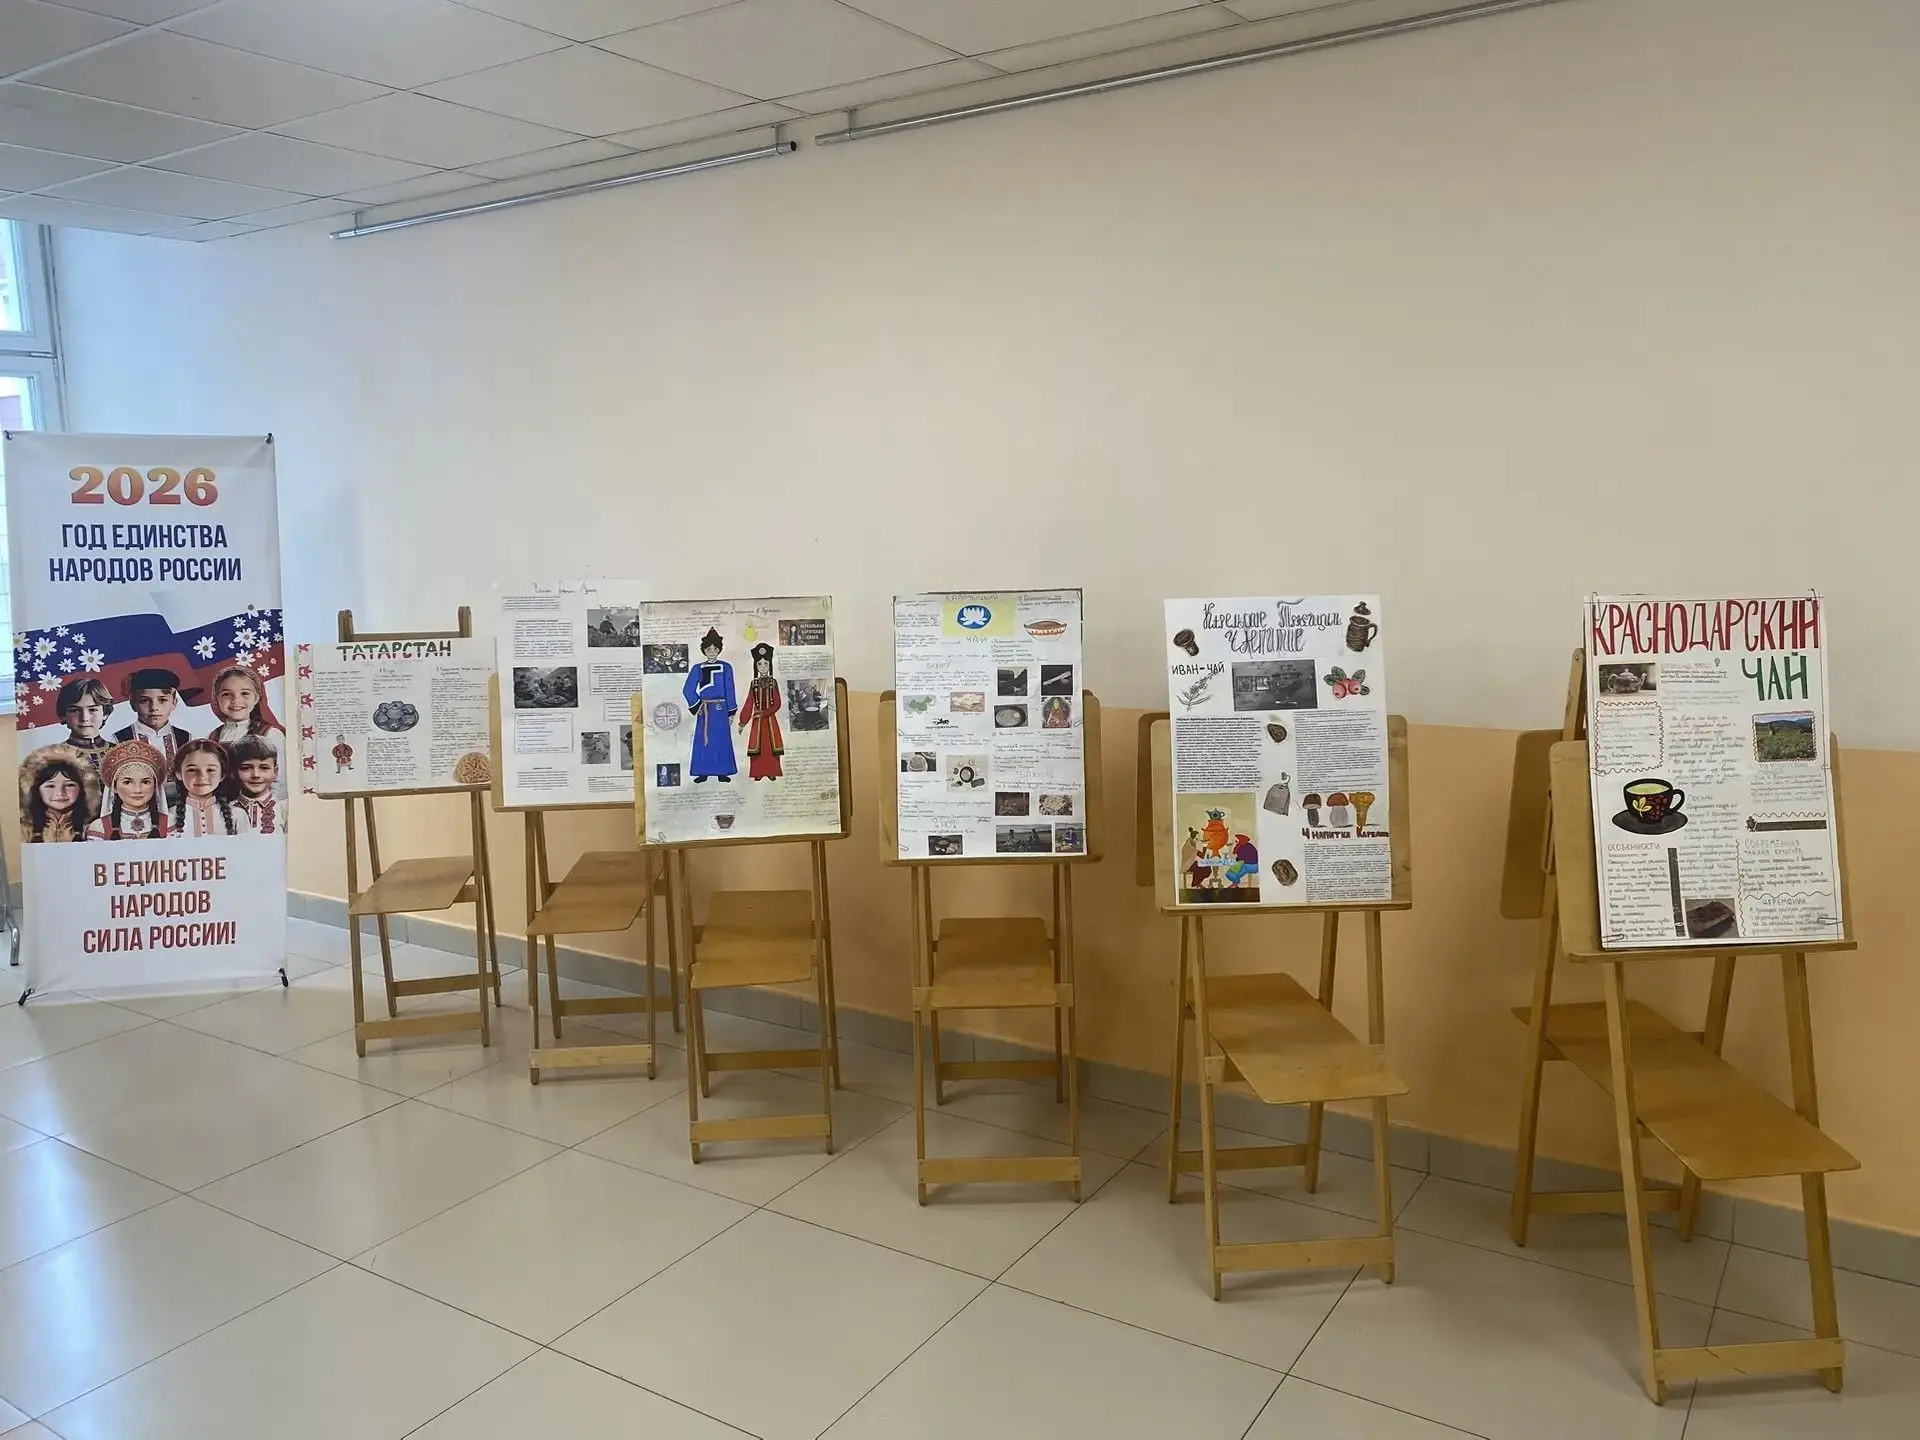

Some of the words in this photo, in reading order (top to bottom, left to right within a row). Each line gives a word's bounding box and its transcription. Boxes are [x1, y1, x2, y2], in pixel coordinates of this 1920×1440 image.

[68, 465, 219, 507] 2026
[62, 524, 107, 550] ГОД
[112, 522, 228, 550] ЕДИНСТВА
[49, 557, 154, 585] НАРОДОВ
[159, 557, 242, 582] РОССИИ
[1592, 598, 1820, 656] КРАСНОДАРСКИЙ
[336, 640, 451, 661] ТАТАРСТАН
[1171, 661, 1225, 675] ИВАН-ЧАЙ
[1741, 652, 1809, 701] ЧАЙ
[93, 863, 107, 886] В
[113, 857, 226, 887] ЕДИНСТВЕ
[110, 889, 211, 919] НАРОДОВ
[83, 927, 144, 954] СИЛА
[148, 921, 237, 950] РОССИИ!
